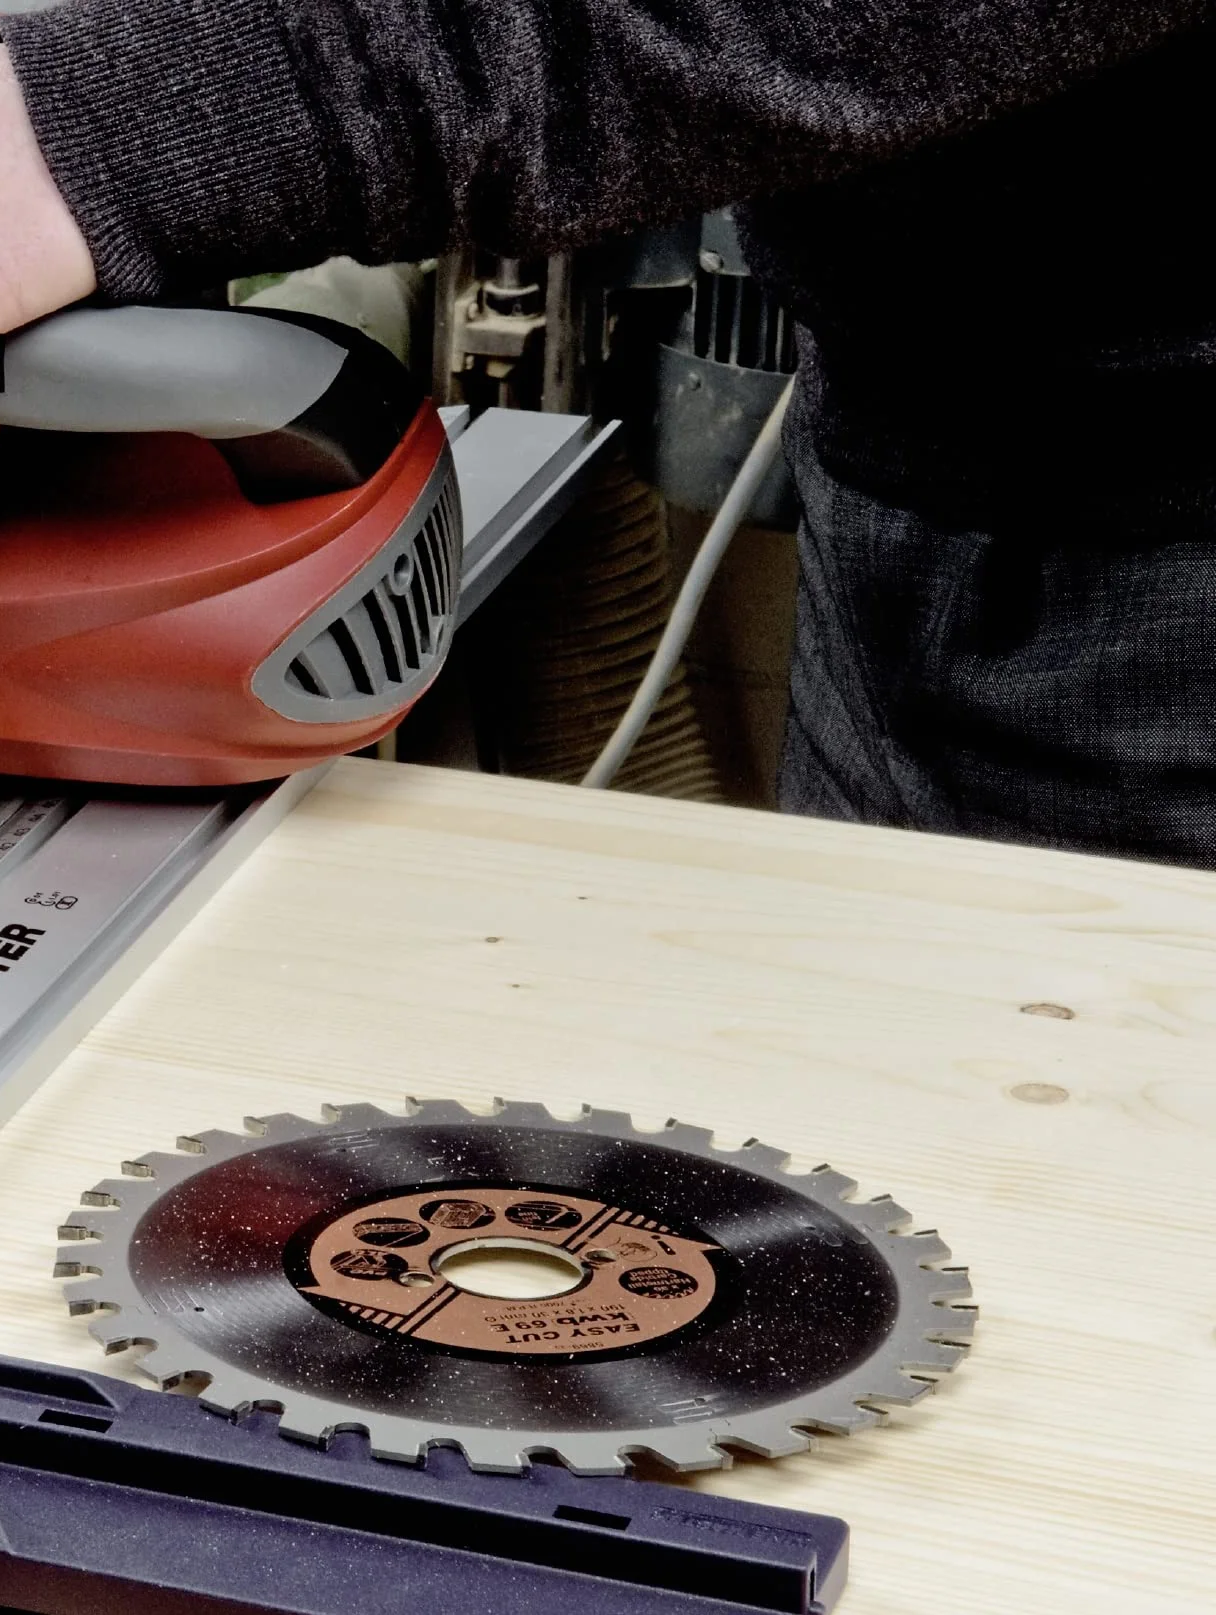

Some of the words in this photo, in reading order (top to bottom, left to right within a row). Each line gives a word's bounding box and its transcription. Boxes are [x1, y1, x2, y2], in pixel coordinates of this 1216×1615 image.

[515, 1320, 547, 1330] 69
[556, 1312, 630, 1326] kwb
[490, 1323, 510, 1332] E
[570, 1323, 641, 1338] EASY
[505, 1331, 560, 1344] CUT
